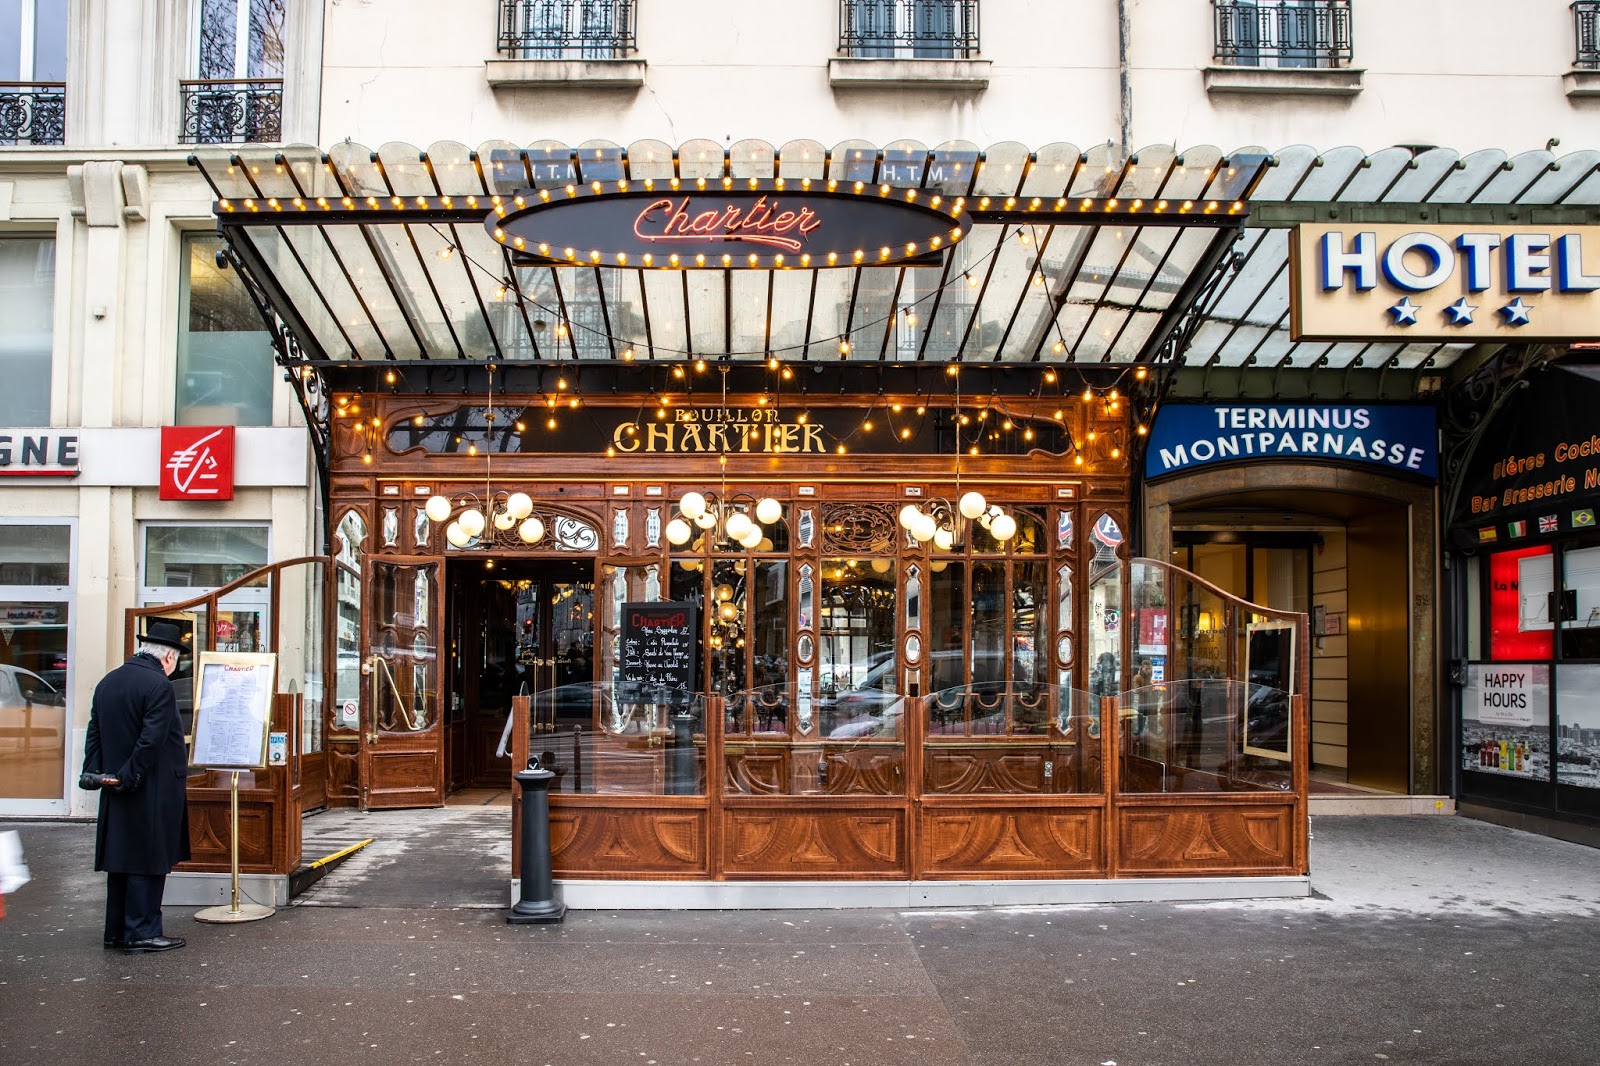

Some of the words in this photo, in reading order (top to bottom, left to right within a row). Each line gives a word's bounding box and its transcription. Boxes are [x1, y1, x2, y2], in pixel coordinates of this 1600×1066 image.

[634, 195, 821, 252] Chartier
[1321, 231, 1600, 292] HOTEL
[1214, 407, 1370, 430] TERMINUS
[613, 422, 827, 453] CHARTIER
[1159, 431, 1426, 471] MONTPARNASSE
[1471, 495, 1498, 513] Bar
[1503, 474, 1576, 506] Brasserie
[631, 613, 685, 627] CHARTIER
[1484, 673, 1525, 689] HAPPY
[1483, 692, 1527, 709] HOURS
